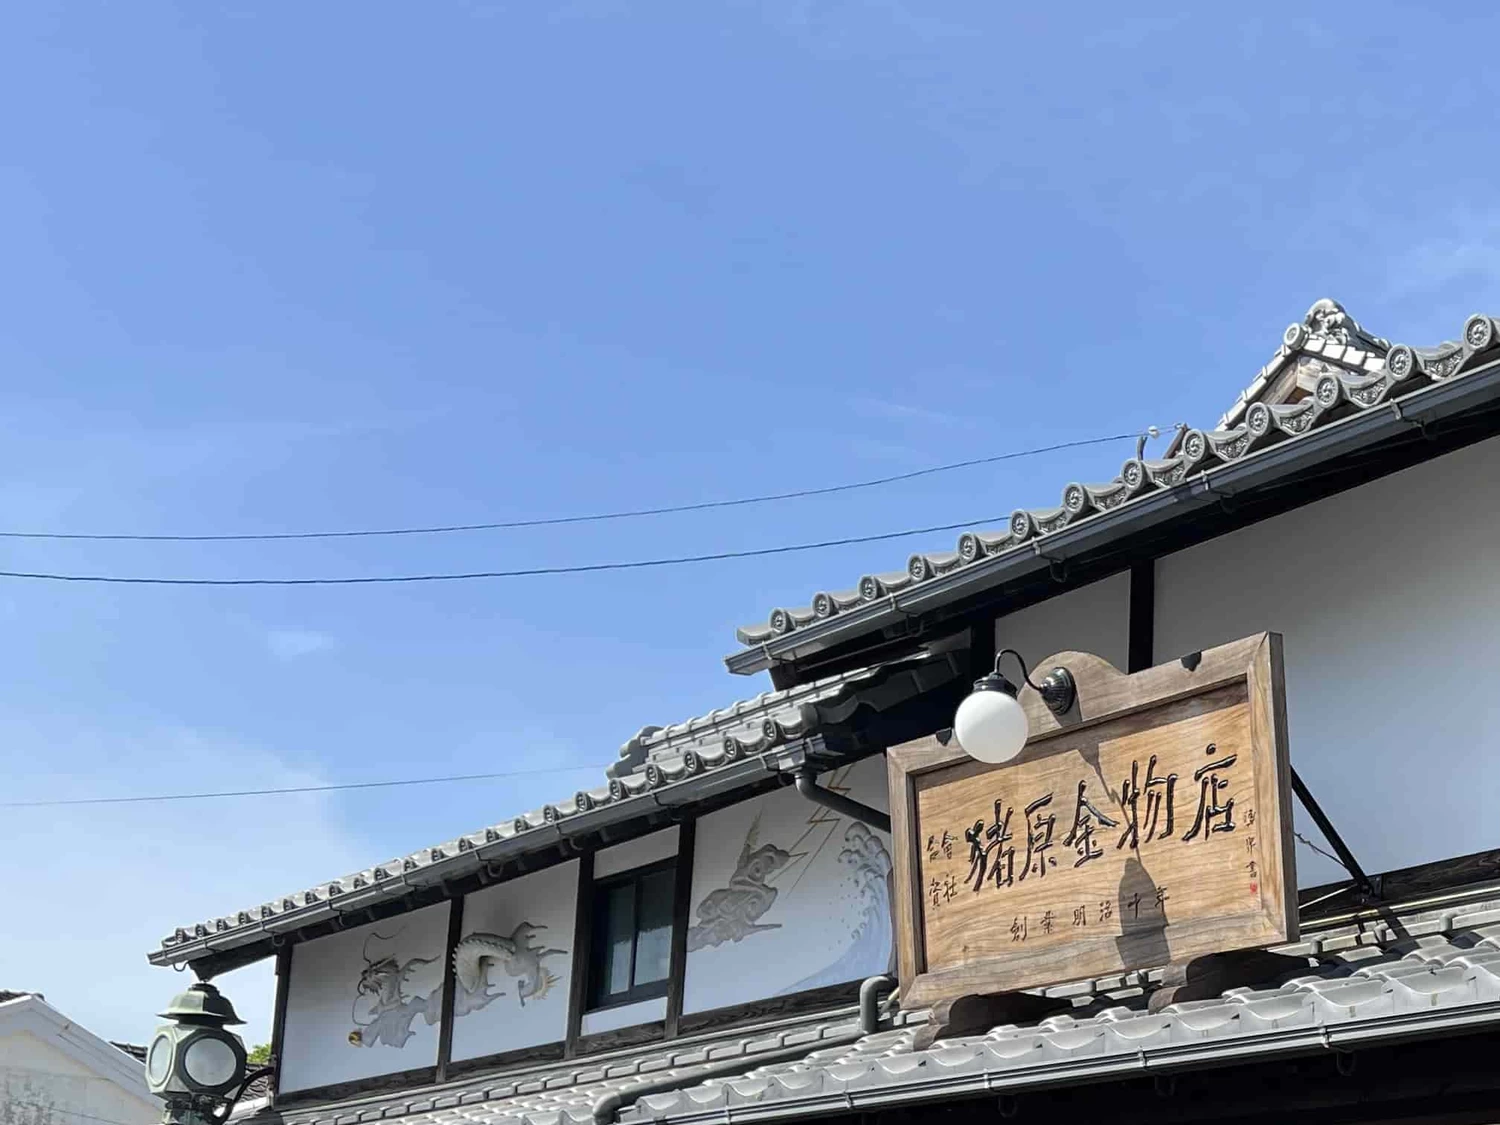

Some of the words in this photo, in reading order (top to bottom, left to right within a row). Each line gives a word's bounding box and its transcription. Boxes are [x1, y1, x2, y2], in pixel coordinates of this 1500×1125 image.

[964, 742, 1238, 892] 猪原金物店
[1010, 886, 1170, 942] 創業明治十年
